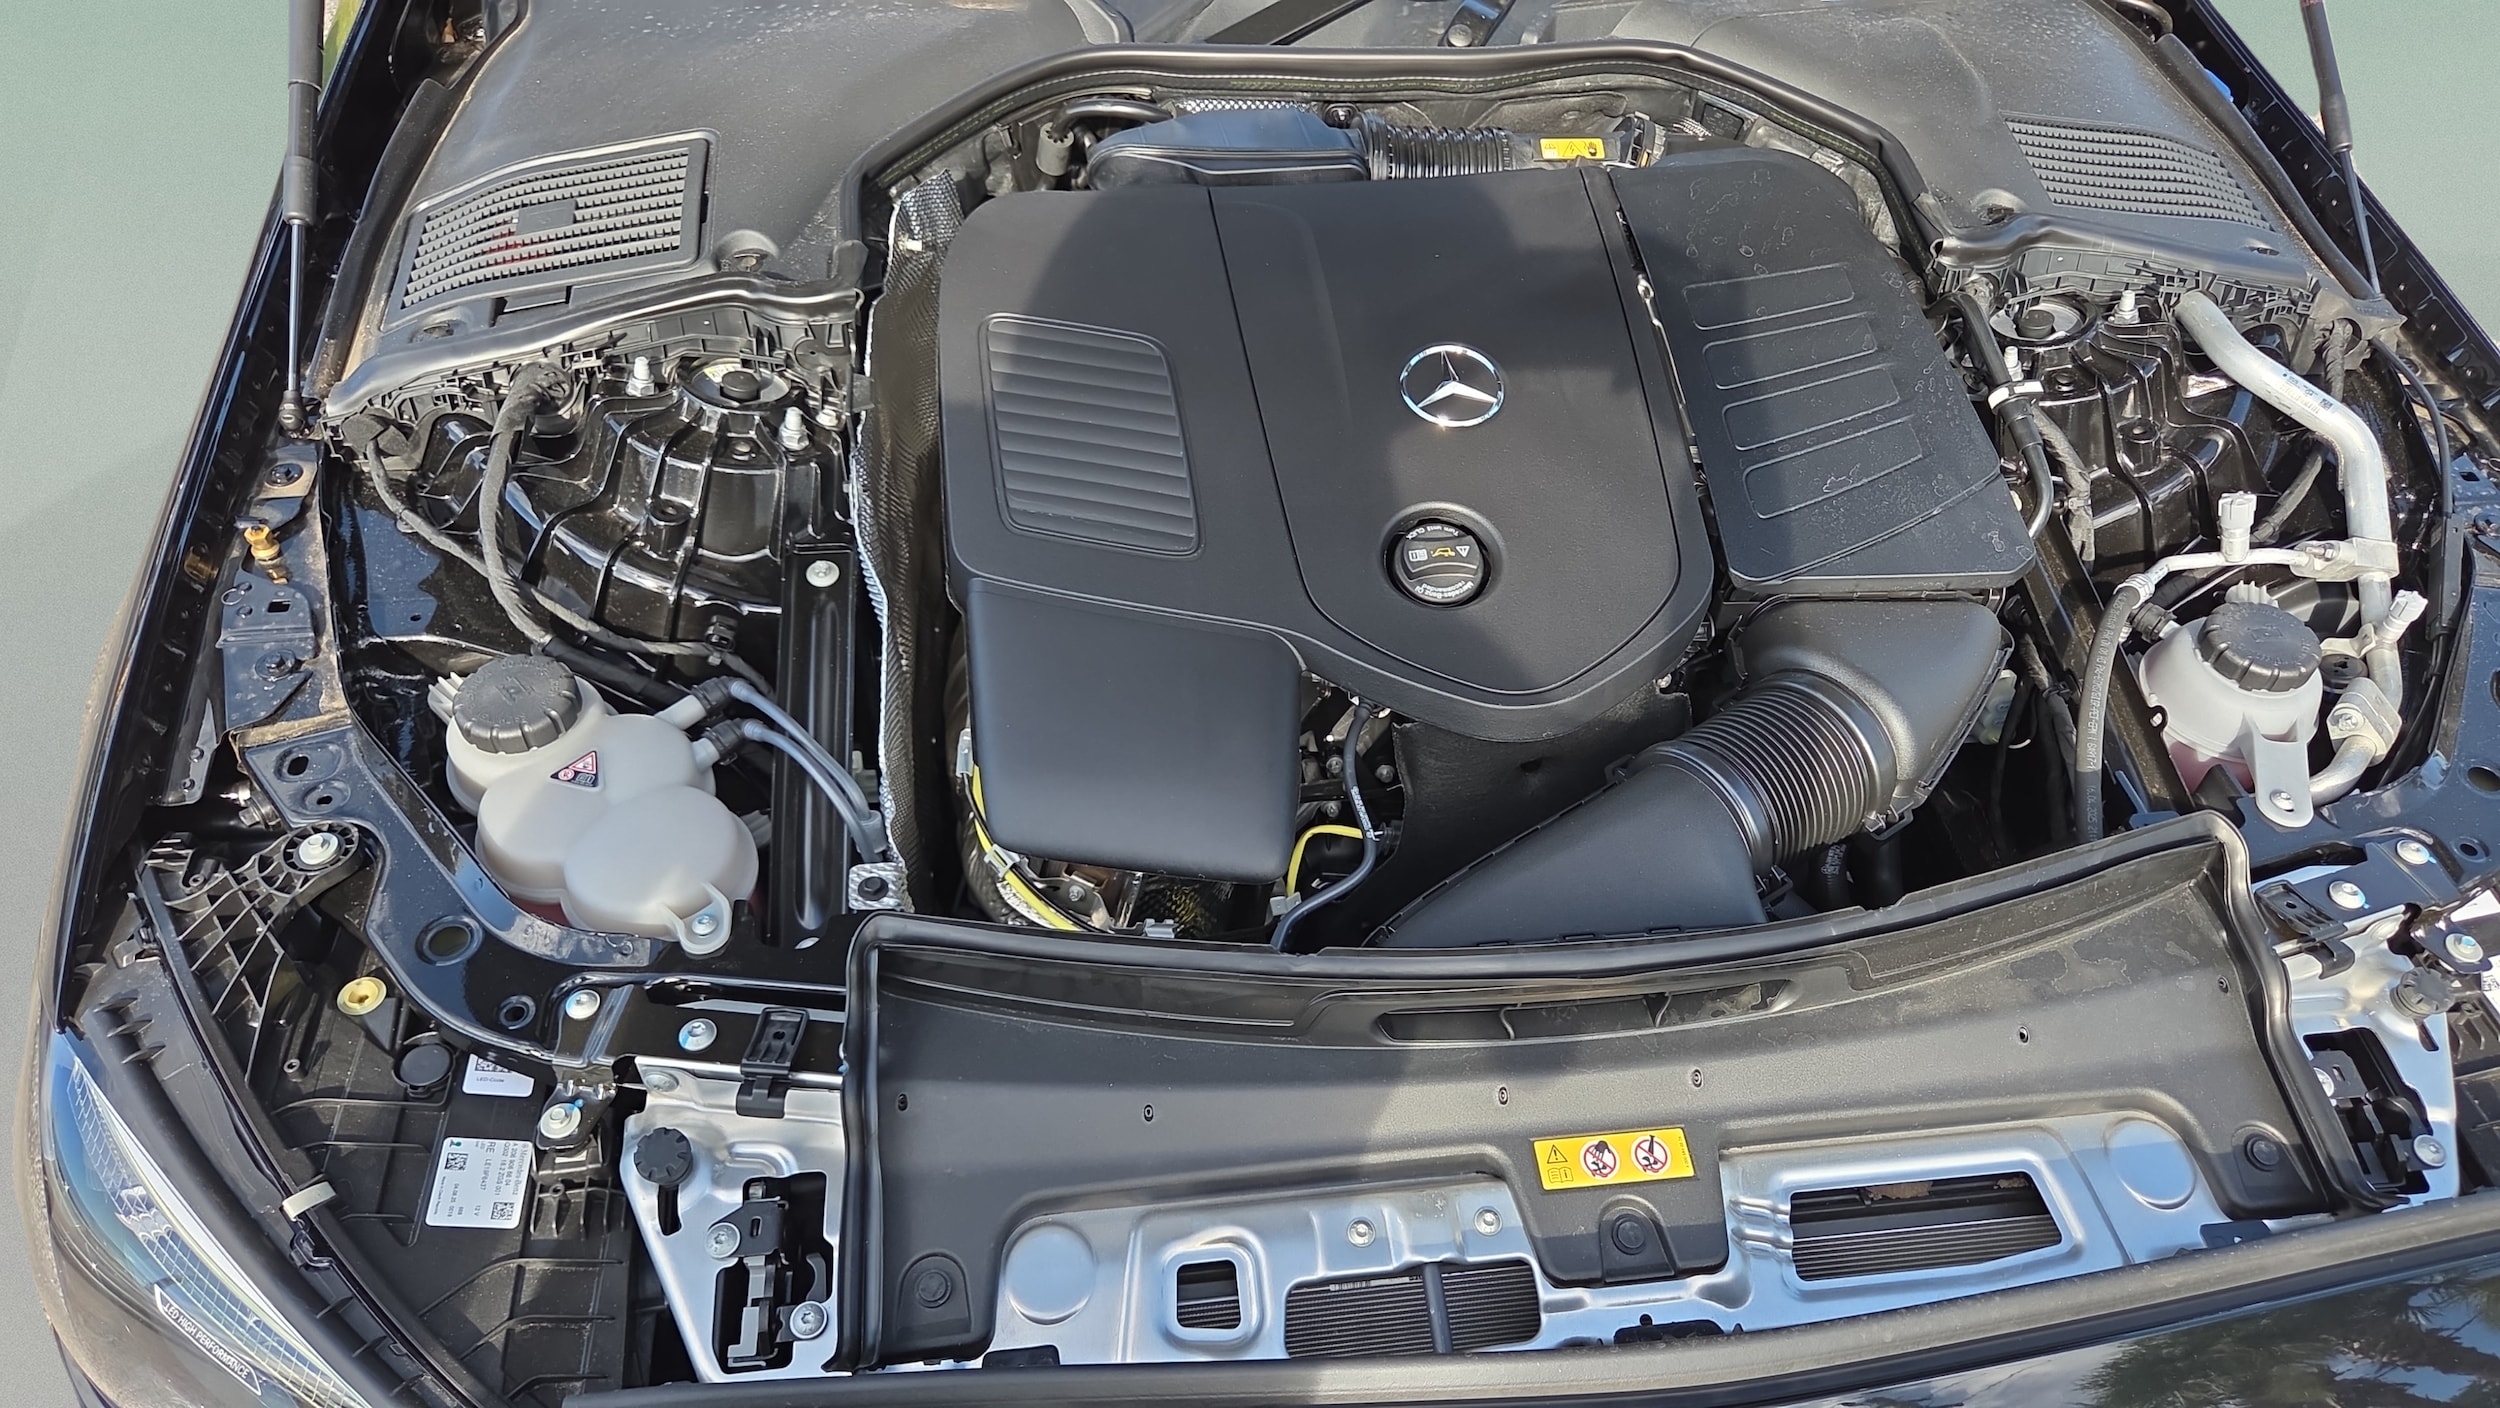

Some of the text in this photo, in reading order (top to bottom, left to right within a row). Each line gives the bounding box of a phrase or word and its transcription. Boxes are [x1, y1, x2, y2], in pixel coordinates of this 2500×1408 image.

[1405, 527, 1425, 540] CLICK
[1443, 527, 1459, 537] Turn
[485, 1141, 497, 1153] RE
[163, 1303, 250, 1379] LED HIGH PERFORMANCE
